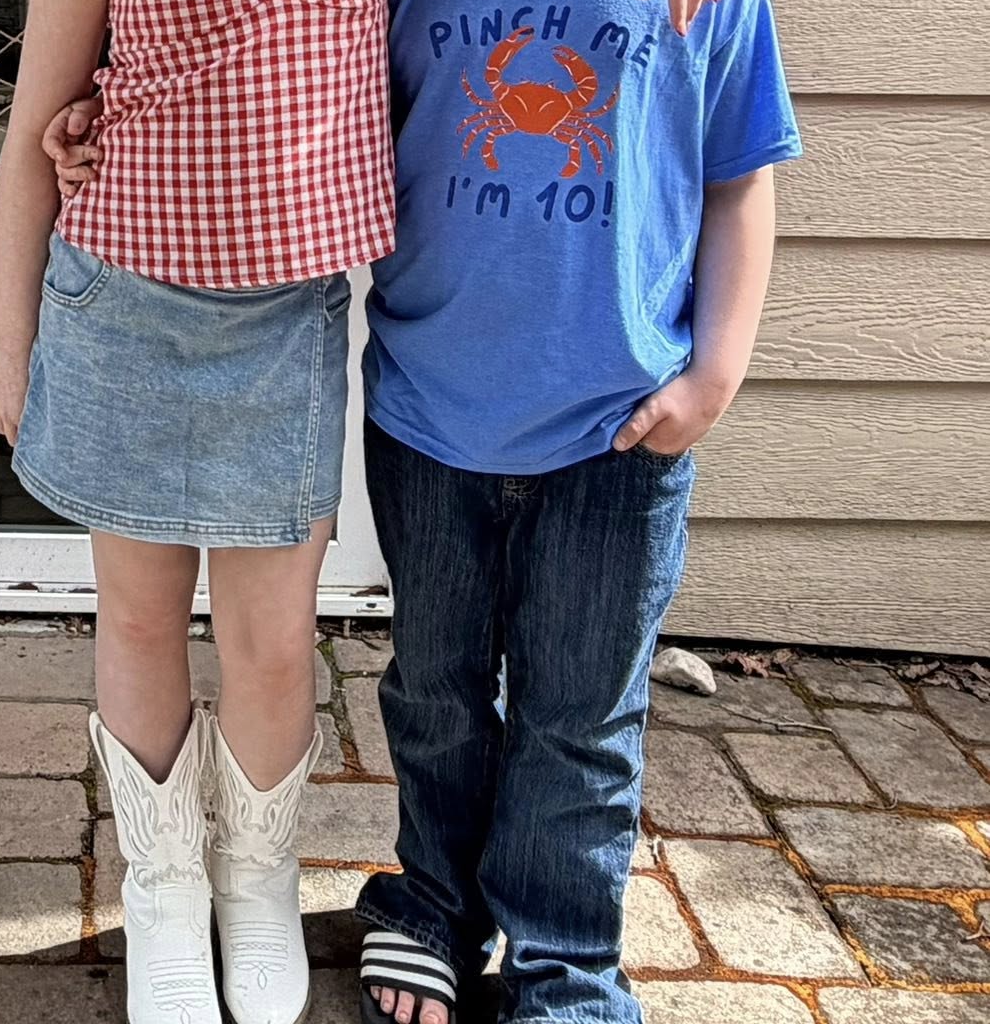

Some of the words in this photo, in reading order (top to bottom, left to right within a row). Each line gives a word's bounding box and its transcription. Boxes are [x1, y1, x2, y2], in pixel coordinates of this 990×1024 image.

[428, 5, 572, 59] PINCH
[589, 21, 659, 69] ME
[446, 175, 511, 219] I'M
[535, 180, 614, 228] 10!
